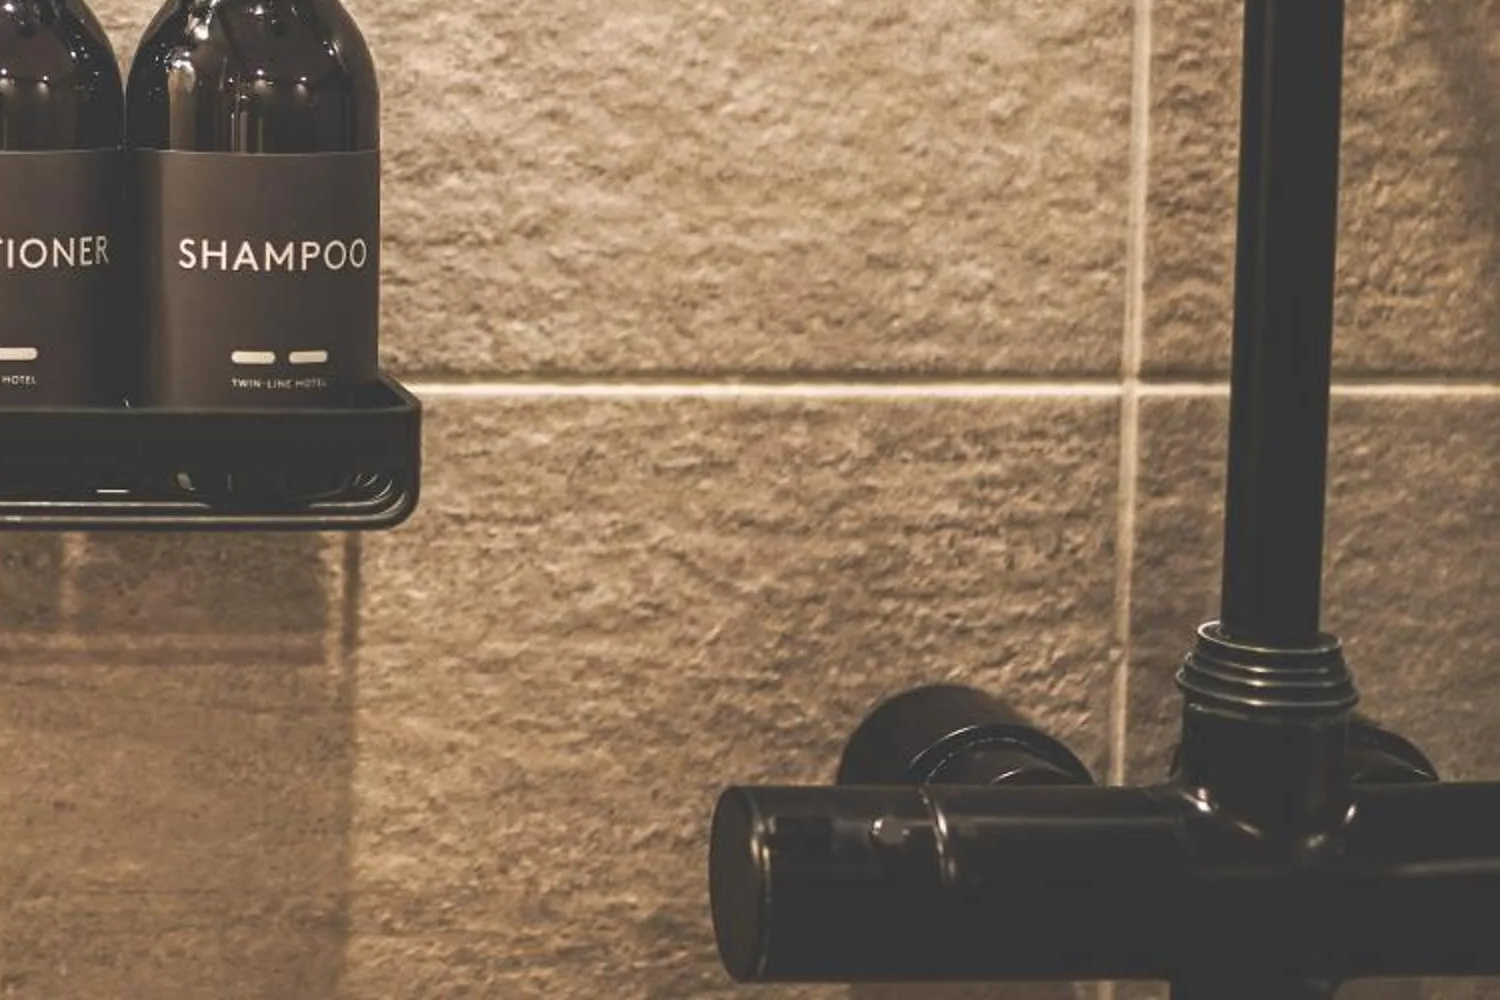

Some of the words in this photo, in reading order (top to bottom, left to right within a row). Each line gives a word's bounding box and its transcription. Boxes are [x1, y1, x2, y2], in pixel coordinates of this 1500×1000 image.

[178, 237, 367, 271] SHAMPOO
[2, 375, 37, 385] HOTEL
[232, 378, 292, 389] TWIN-LINE
